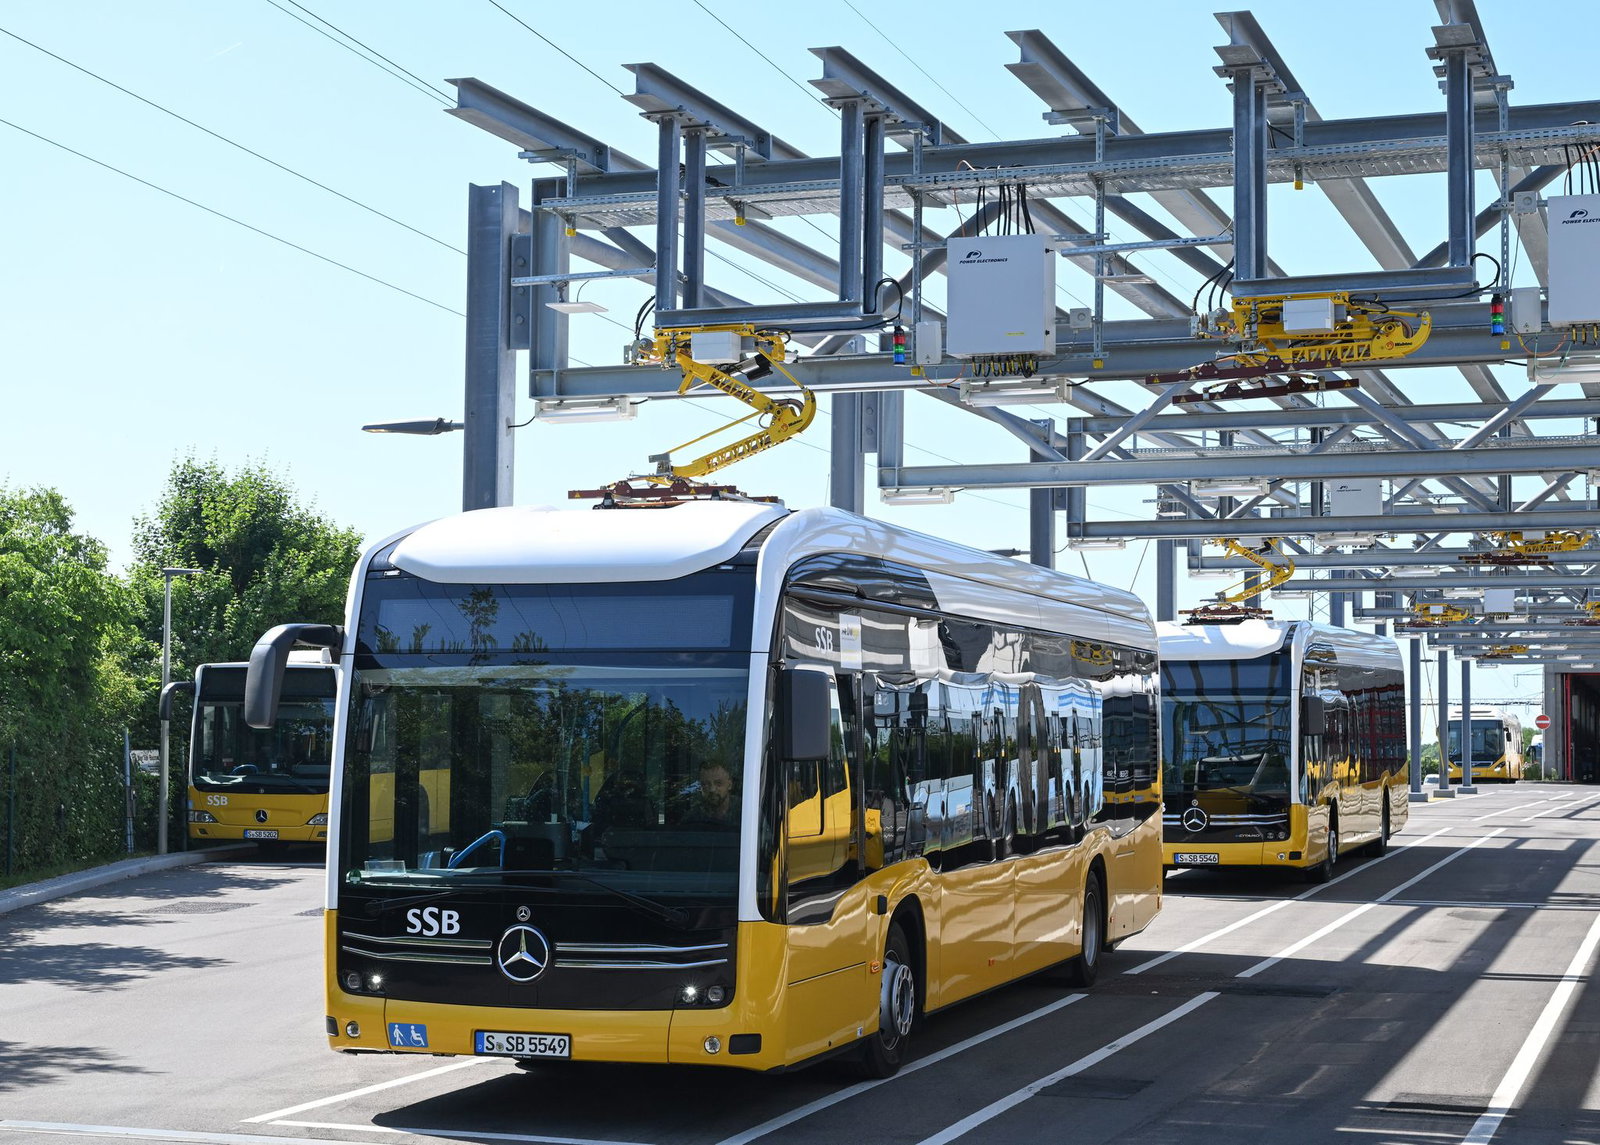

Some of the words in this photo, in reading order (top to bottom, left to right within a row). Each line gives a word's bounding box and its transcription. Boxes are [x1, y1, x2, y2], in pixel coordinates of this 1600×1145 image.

[815, 626, 833, 655] SSB
[207, 795, 228, 806] SSB
[1199, 855, 1217, 863] 5546
[406, 906, 461, 936] SSB
[485, 1035, 495, 1051] S
[505, 1036, 525, 1052] SB
[528, 1037, 567, 1054] 5549
